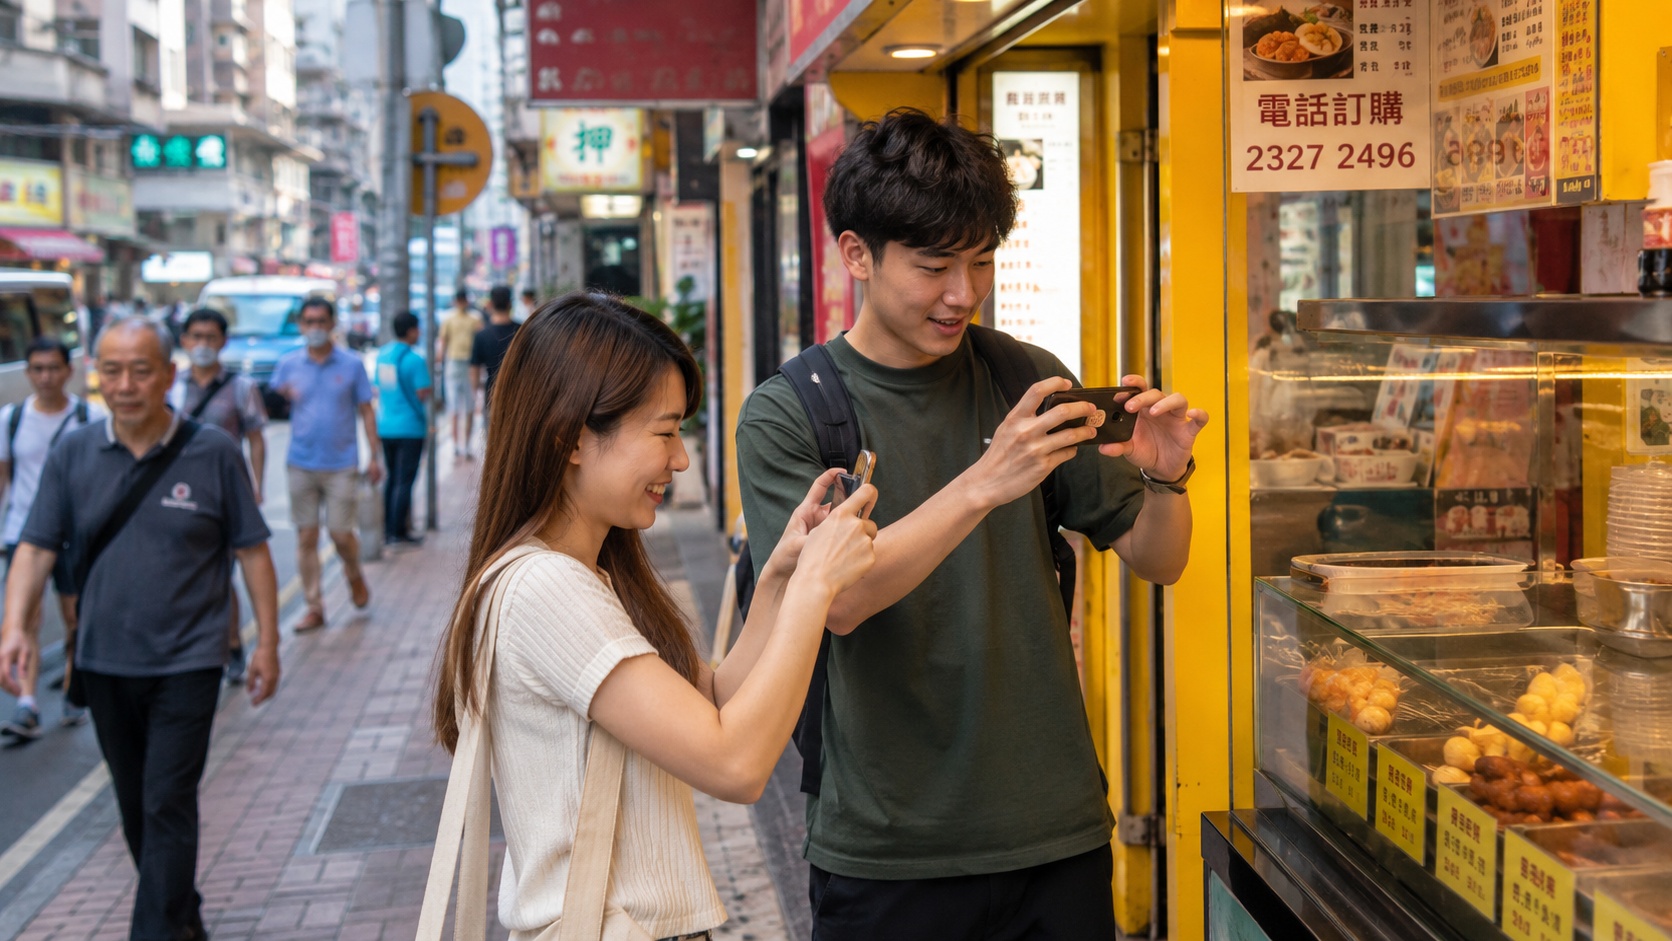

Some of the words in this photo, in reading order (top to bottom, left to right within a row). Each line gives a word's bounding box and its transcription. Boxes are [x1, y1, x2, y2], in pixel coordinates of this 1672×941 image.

[1258, 91, 1403, 127] 電話訂購
[572, 119, 613, 164] 押
[1246, 144, 1324, 171] 2327
[1337, 142, 1416, 169] 2496
